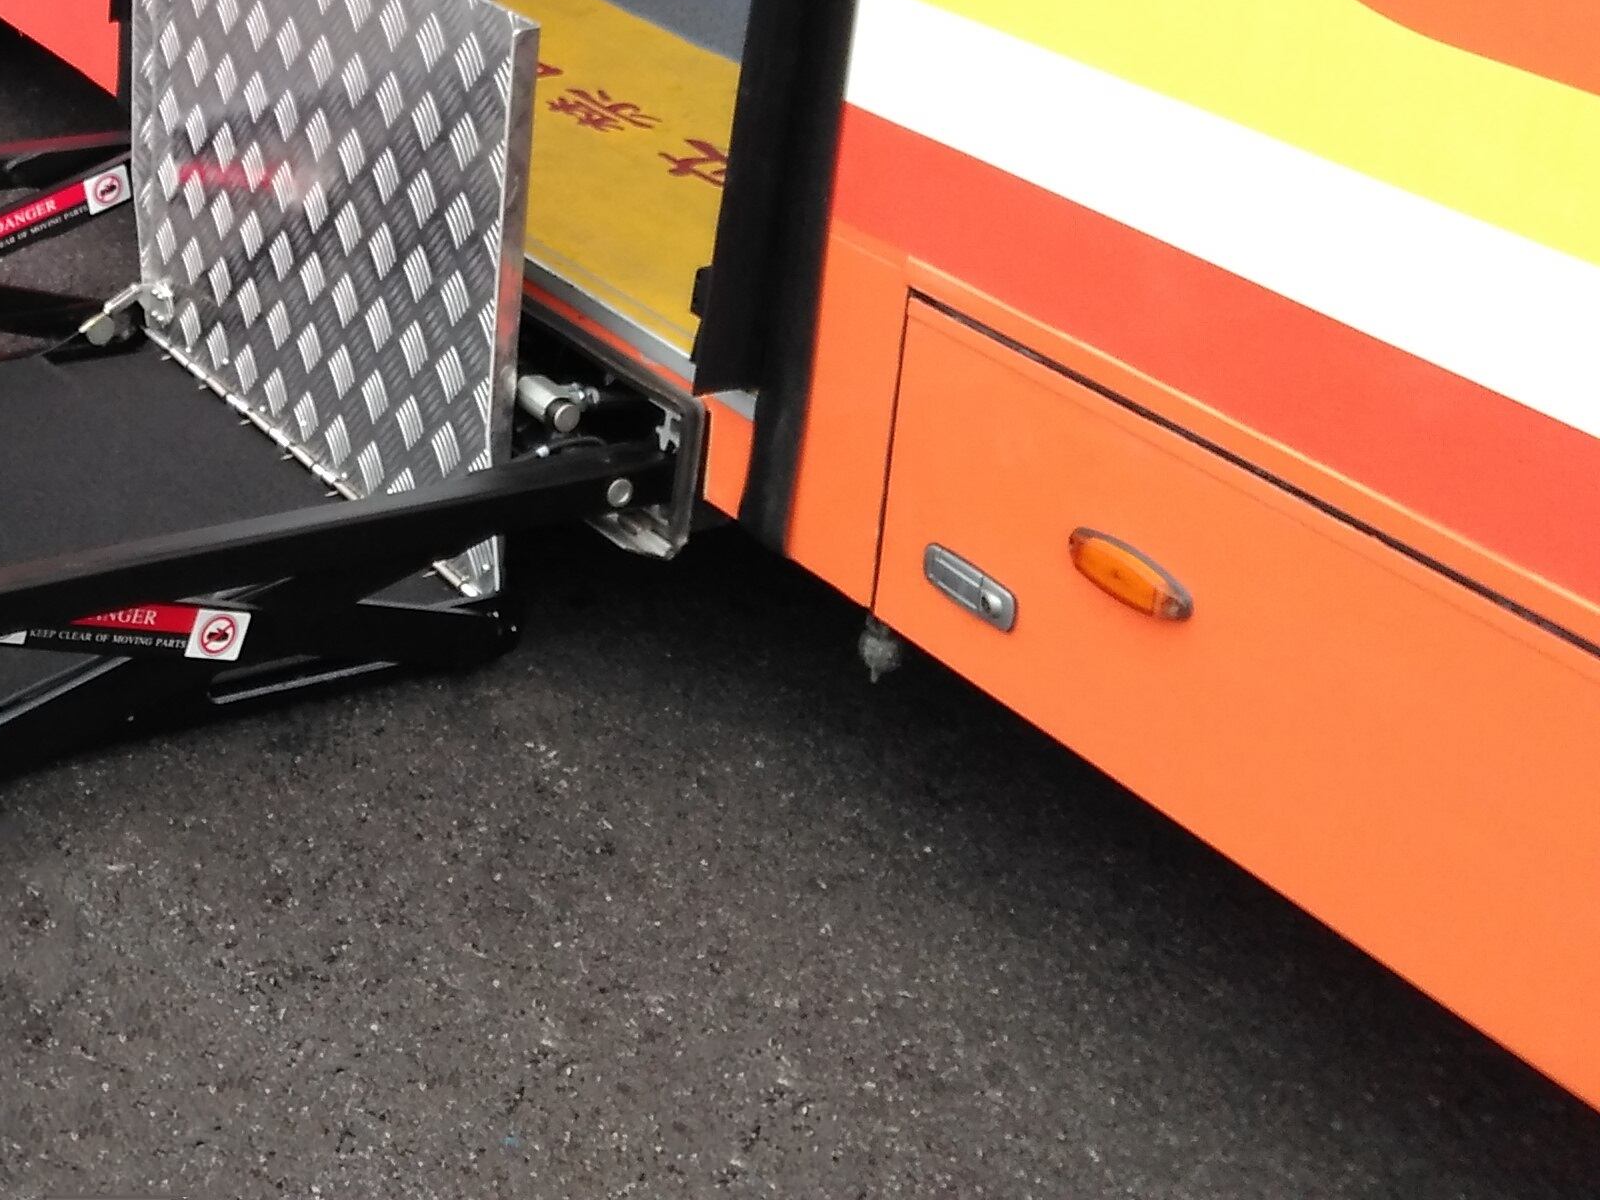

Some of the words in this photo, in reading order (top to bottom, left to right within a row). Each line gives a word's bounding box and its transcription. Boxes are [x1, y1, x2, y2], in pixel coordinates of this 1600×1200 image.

[29, 628, 56, 638] KEEP
[58, 631, 92, 642] CLEAR
[95, 634, 110, 643] OF
[112, 635, 152, 647] MOVING
[155, 638, 188, 649] PARTS
